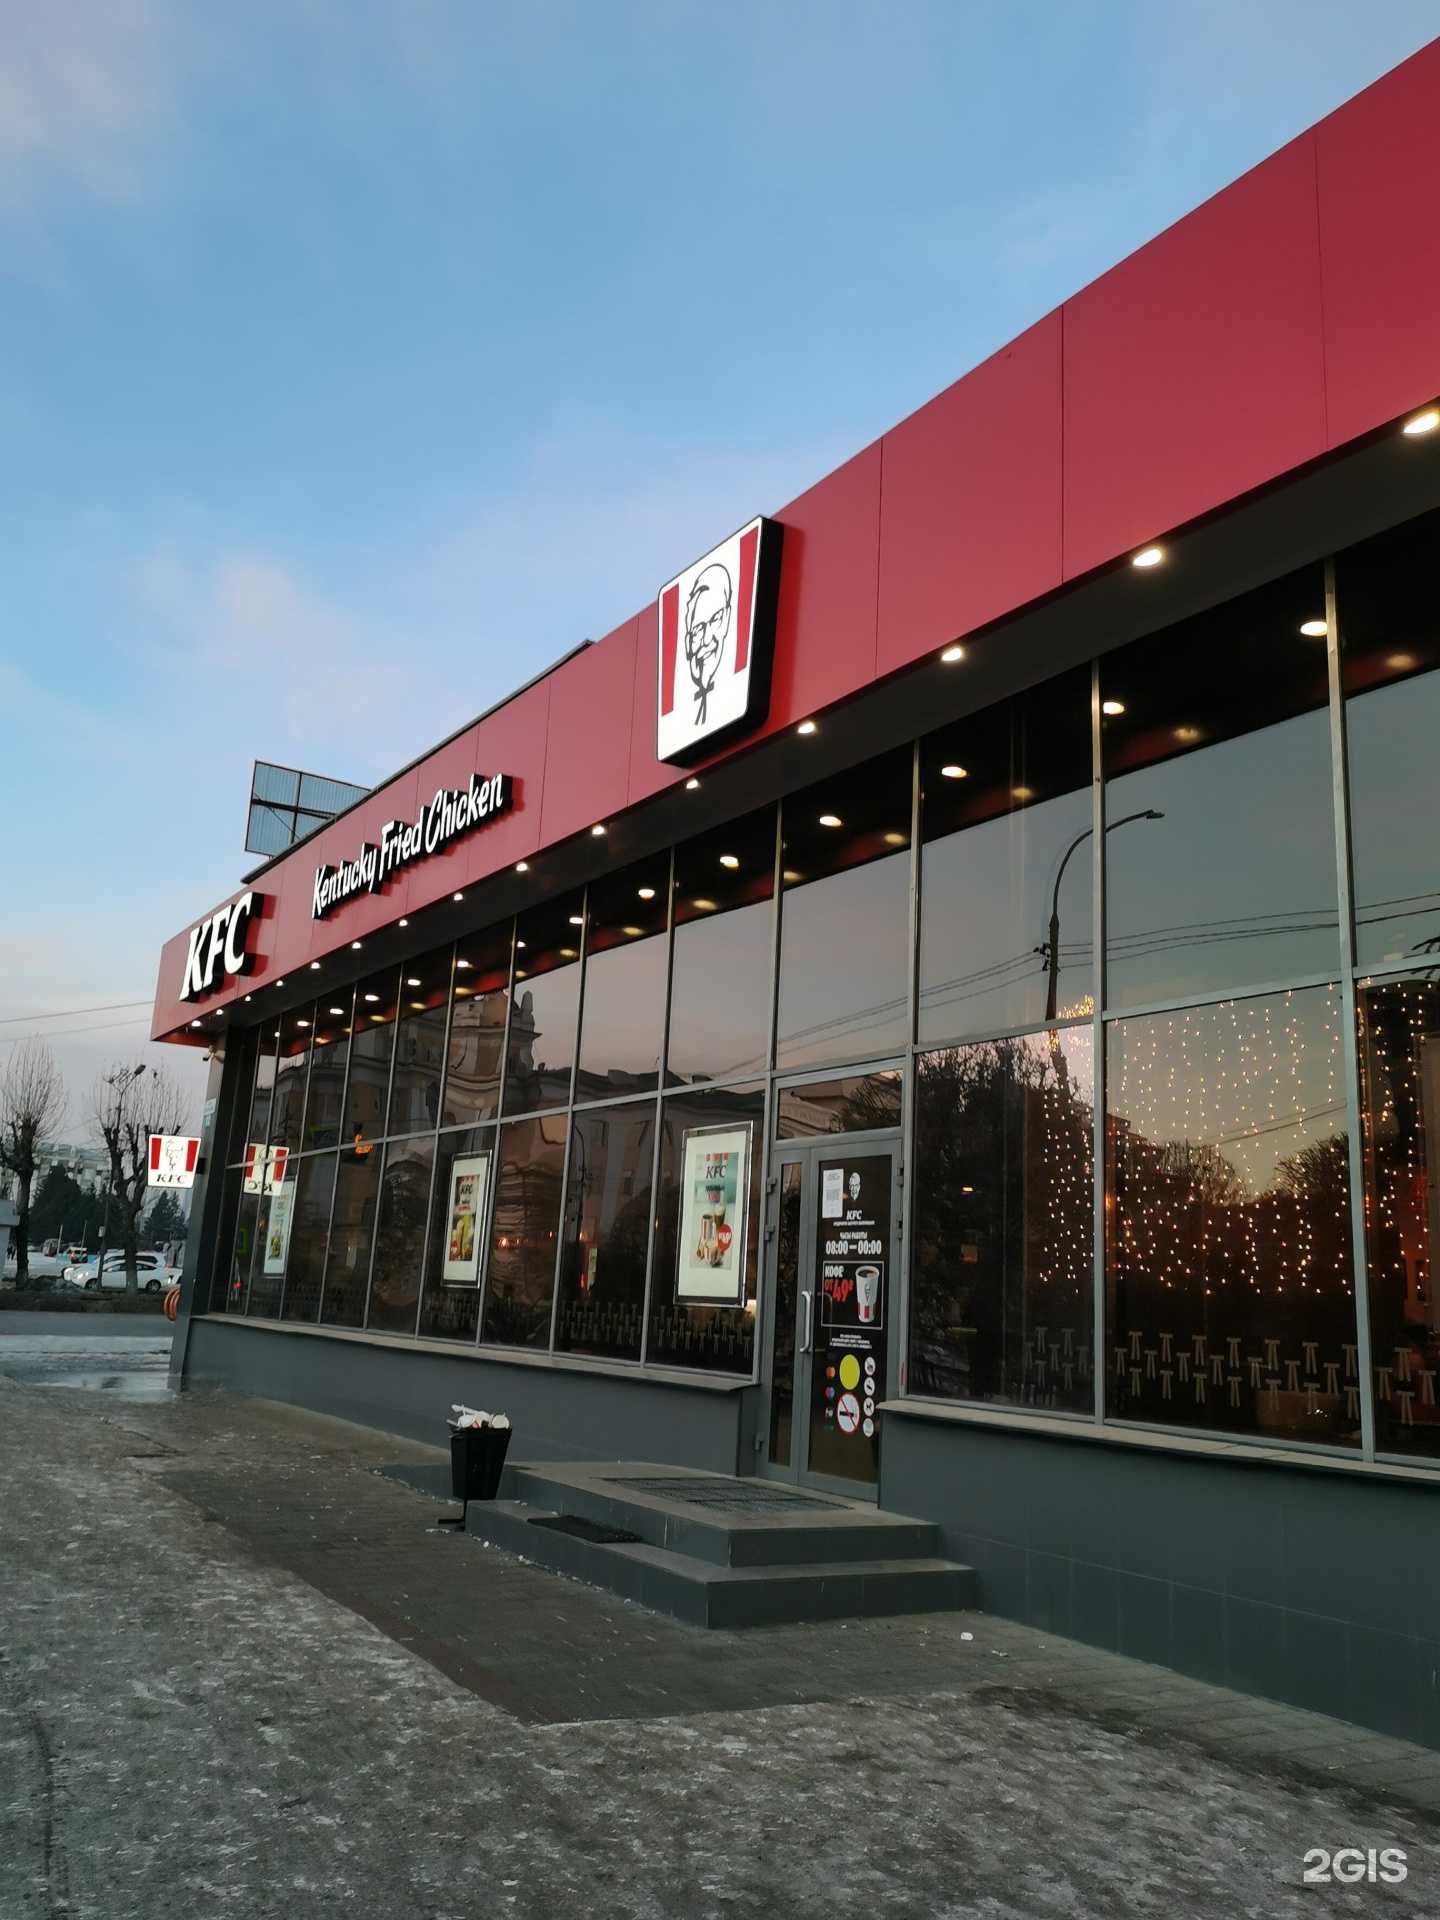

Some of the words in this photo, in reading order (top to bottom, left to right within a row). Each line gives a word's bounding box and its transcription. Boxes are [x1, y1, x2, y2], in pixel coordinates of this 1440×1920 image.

[312, 842, 378, 919] Kentucky
[379, 805, 425, 881] Fried
[425, 773, 504, 854] Chicken
[179, 891, 254, 1002] KFC
[156, 1173, 185, 1184] KFC
[706, 1165, 726, 1179] KFC
[846, 1210, 861, 1220] KFC
[826, 1241, 848, 1254] 08:00
[858, 1240, 881, 1254] 00:00
[825, 1266, 843, 1277] КОФЕ
